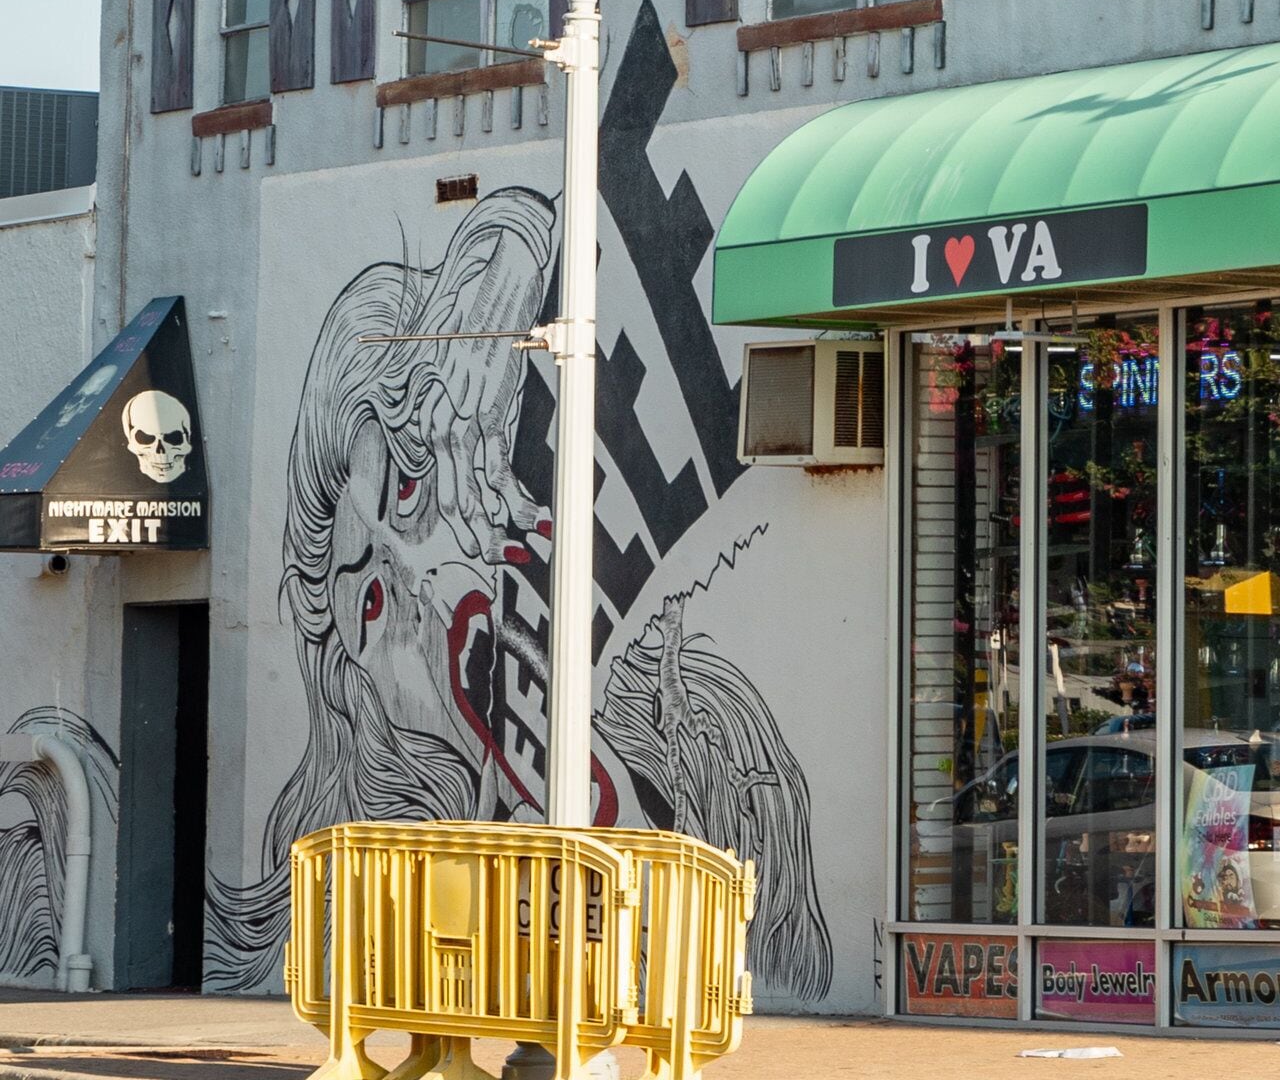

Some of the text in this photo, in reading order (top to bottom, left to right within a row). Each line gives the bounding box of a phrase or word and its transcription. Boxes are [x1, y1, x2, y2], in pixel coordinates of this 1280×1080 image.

[911, 220, 1062, 293] I VA
[49, 500, 200, 517] NIGHTMARE MANSION
[88, 518, 161, 543] EXIT
[1196, 807, 1237, 827] Edibles
[1040, 961, 1085, 1003] Body
